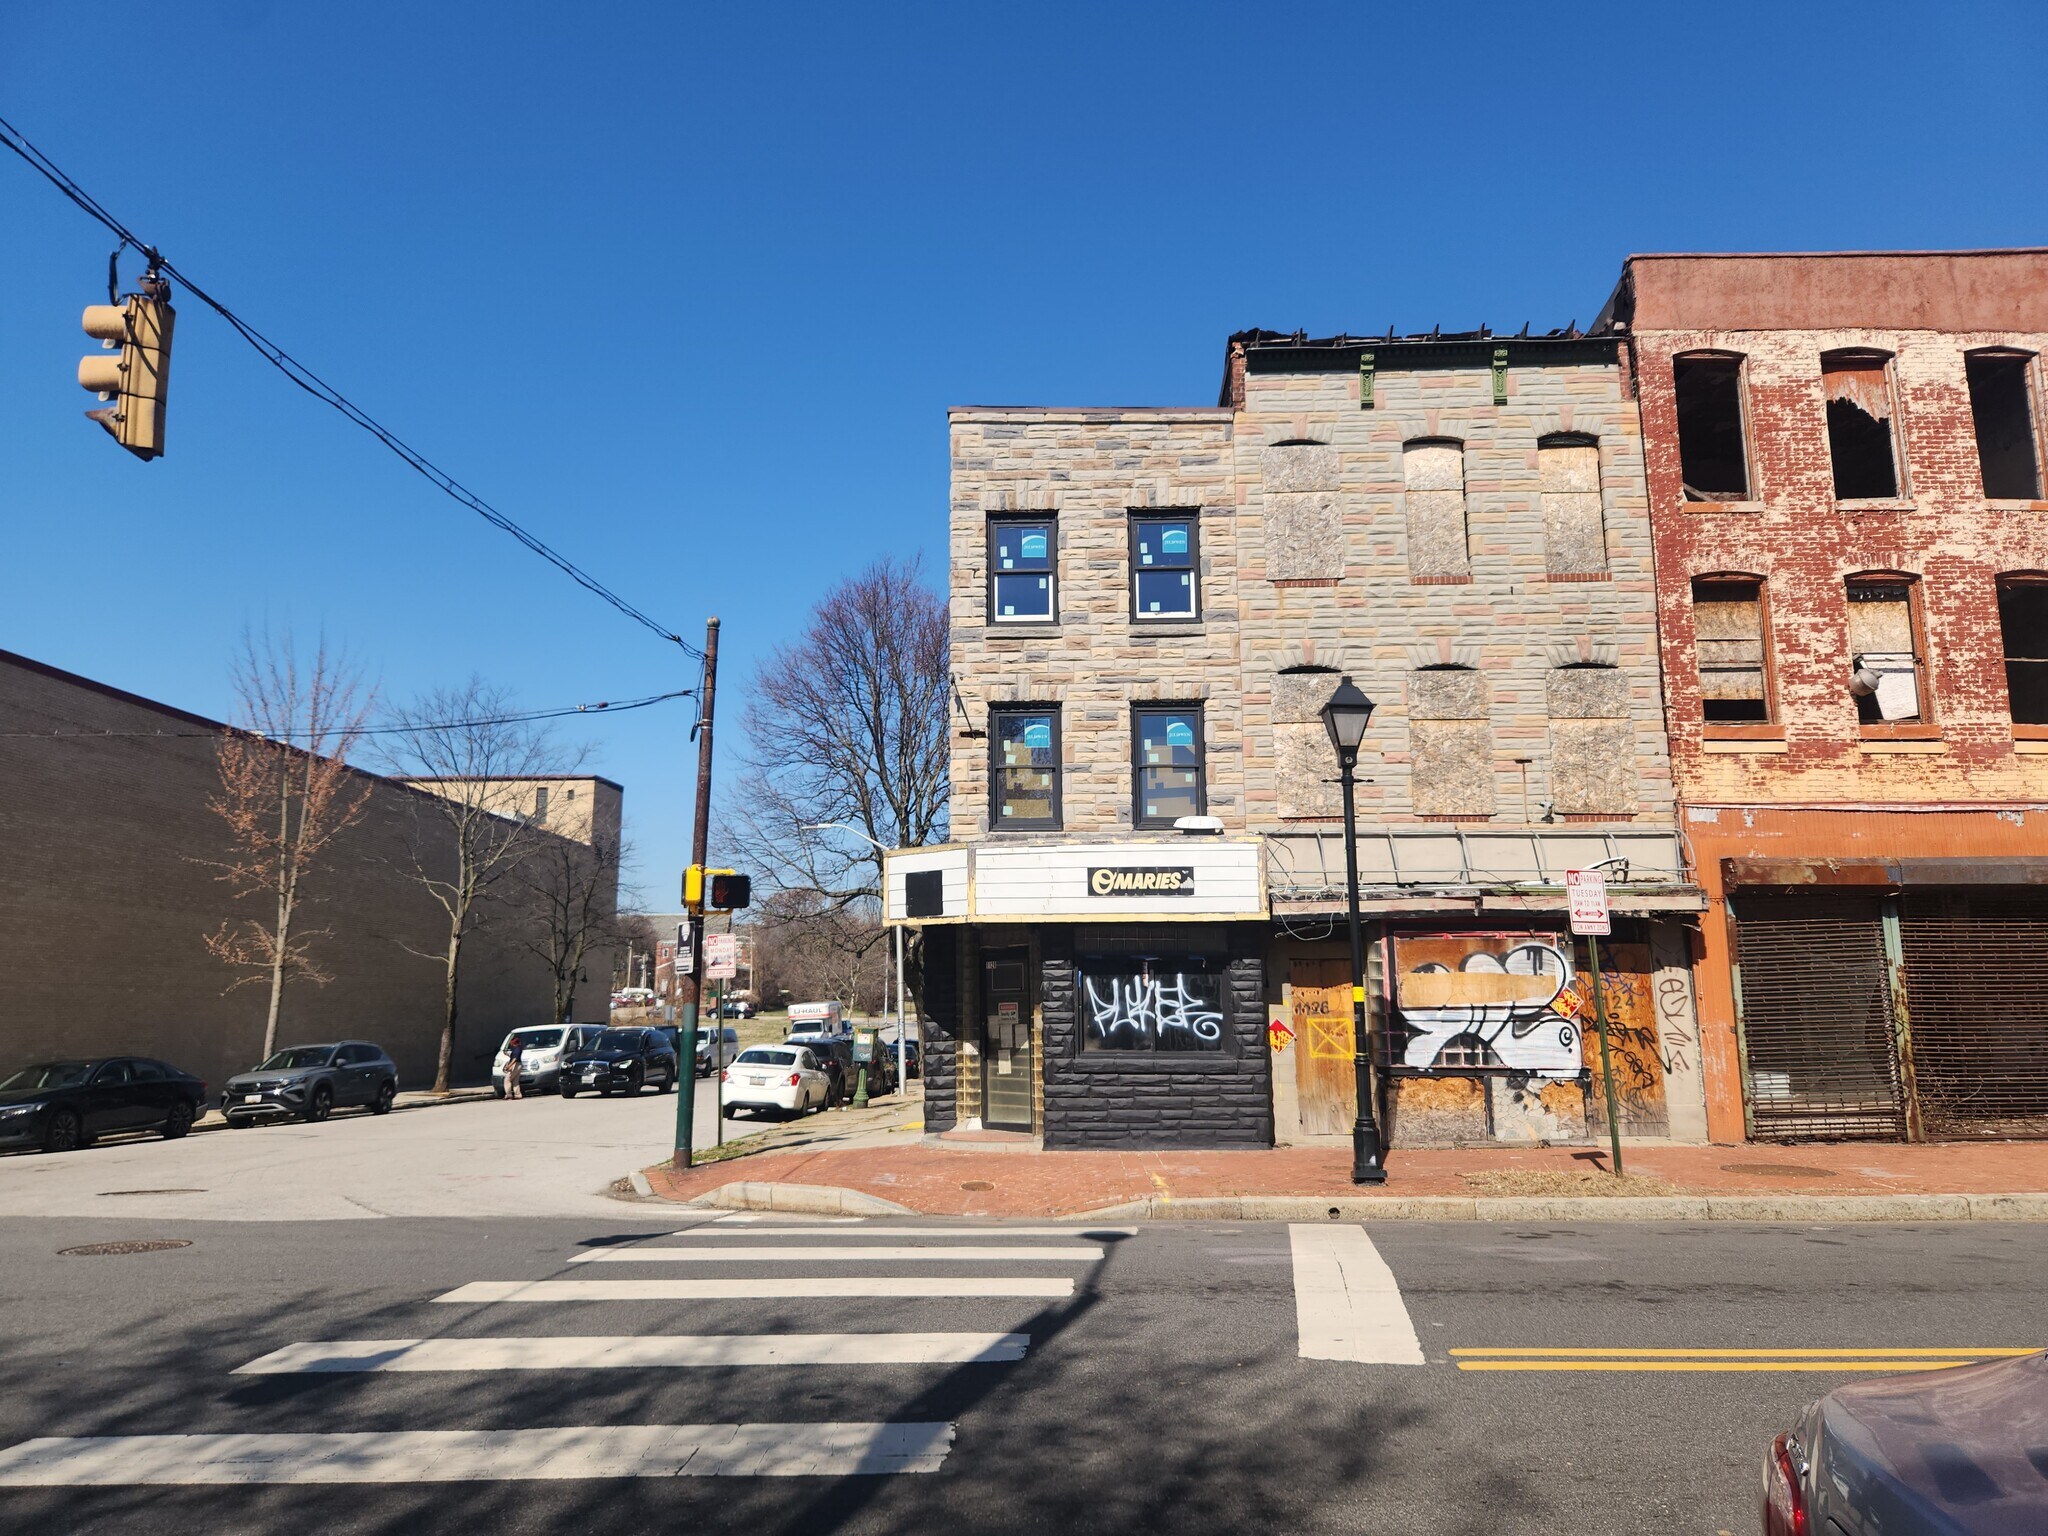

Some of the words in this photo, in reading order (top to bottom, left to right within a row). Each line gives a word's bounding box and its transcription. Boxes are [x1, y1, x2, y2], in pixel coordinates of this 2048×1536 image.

[1568, 872, 1580, 885] NO
[1580, 874, 1602, 884] PARKING
[1571, 888, 1602, 897] TUESDAY
[708, 937, 718, 946] NO
